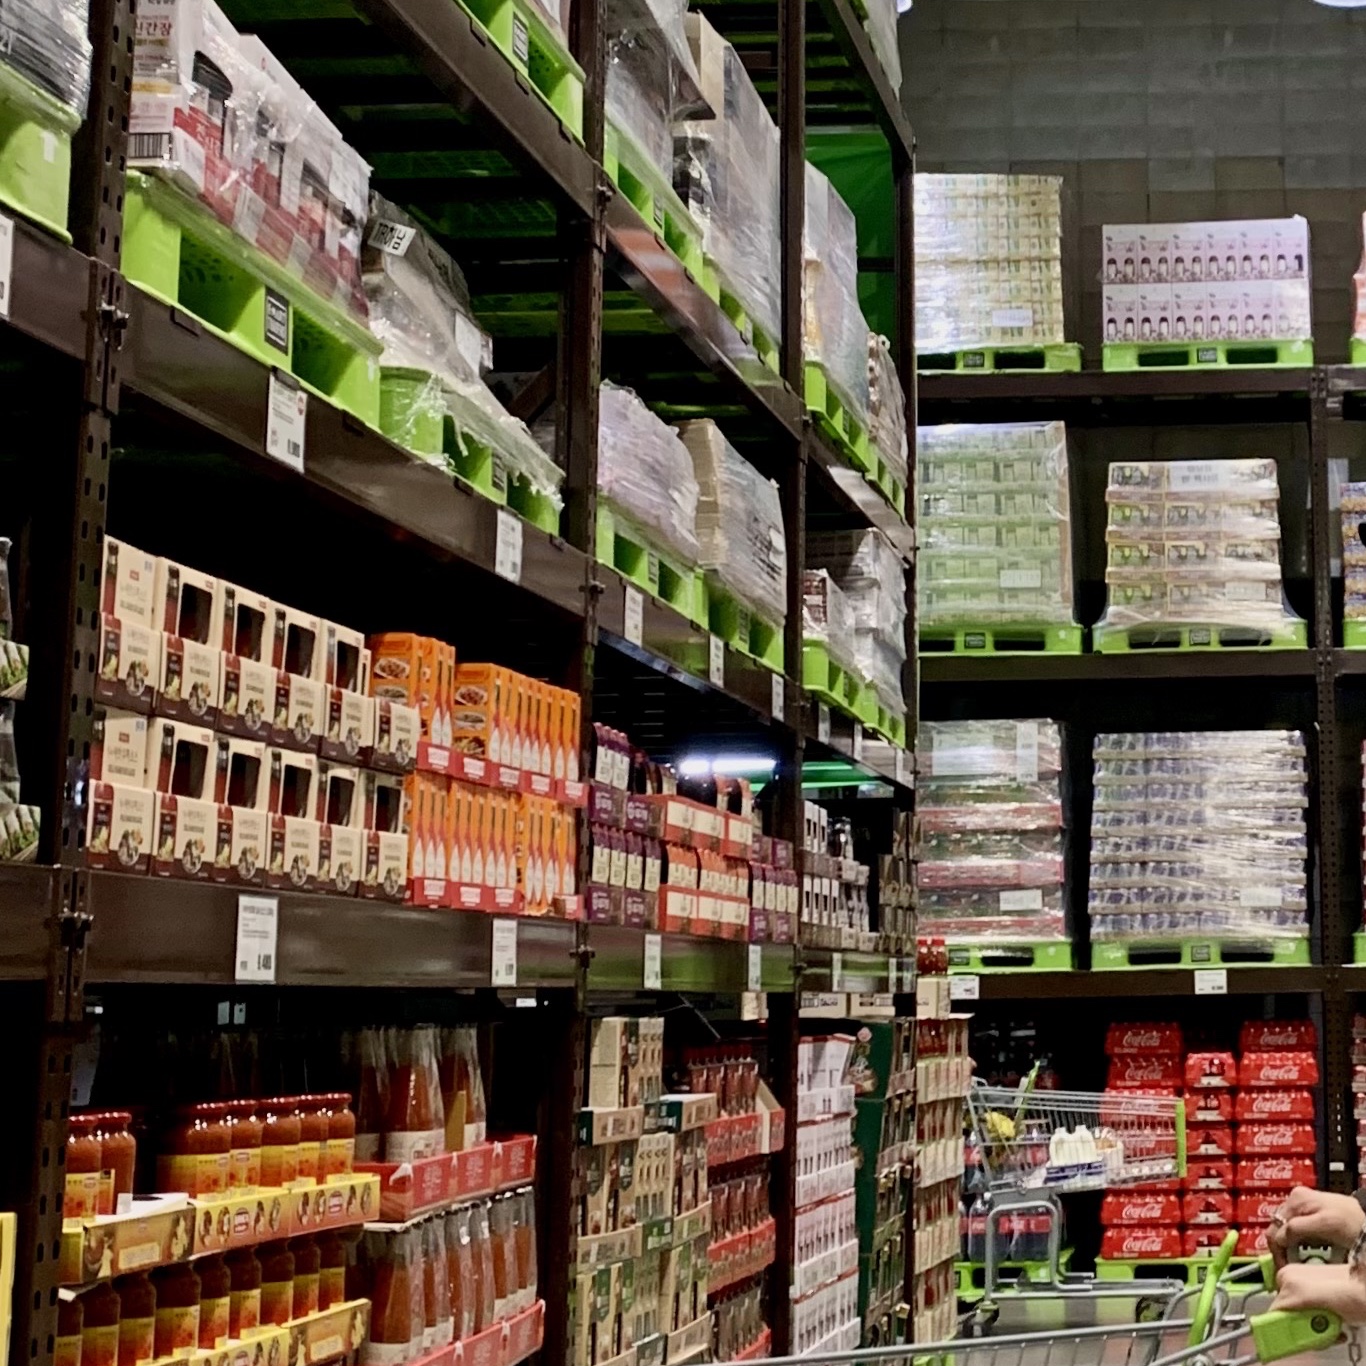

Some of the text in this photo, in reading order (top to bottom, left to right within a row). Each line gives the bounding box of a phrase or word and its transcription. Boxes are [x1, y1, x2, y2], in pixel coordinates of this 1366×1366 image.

[1260, 1065, 1299, 1080] Coca-Cola
[1253, 1097, 1292, 1113] Coca-Cola
[1254, 1130, 1293, 1146] Coca-Cola
[1254, 1163, 1293, 1180] Coca-Cola
[1122, 1204, 1162, 1219] Coca-Cola
[1122, 1236, 1163, 1252] Coca-Cola
